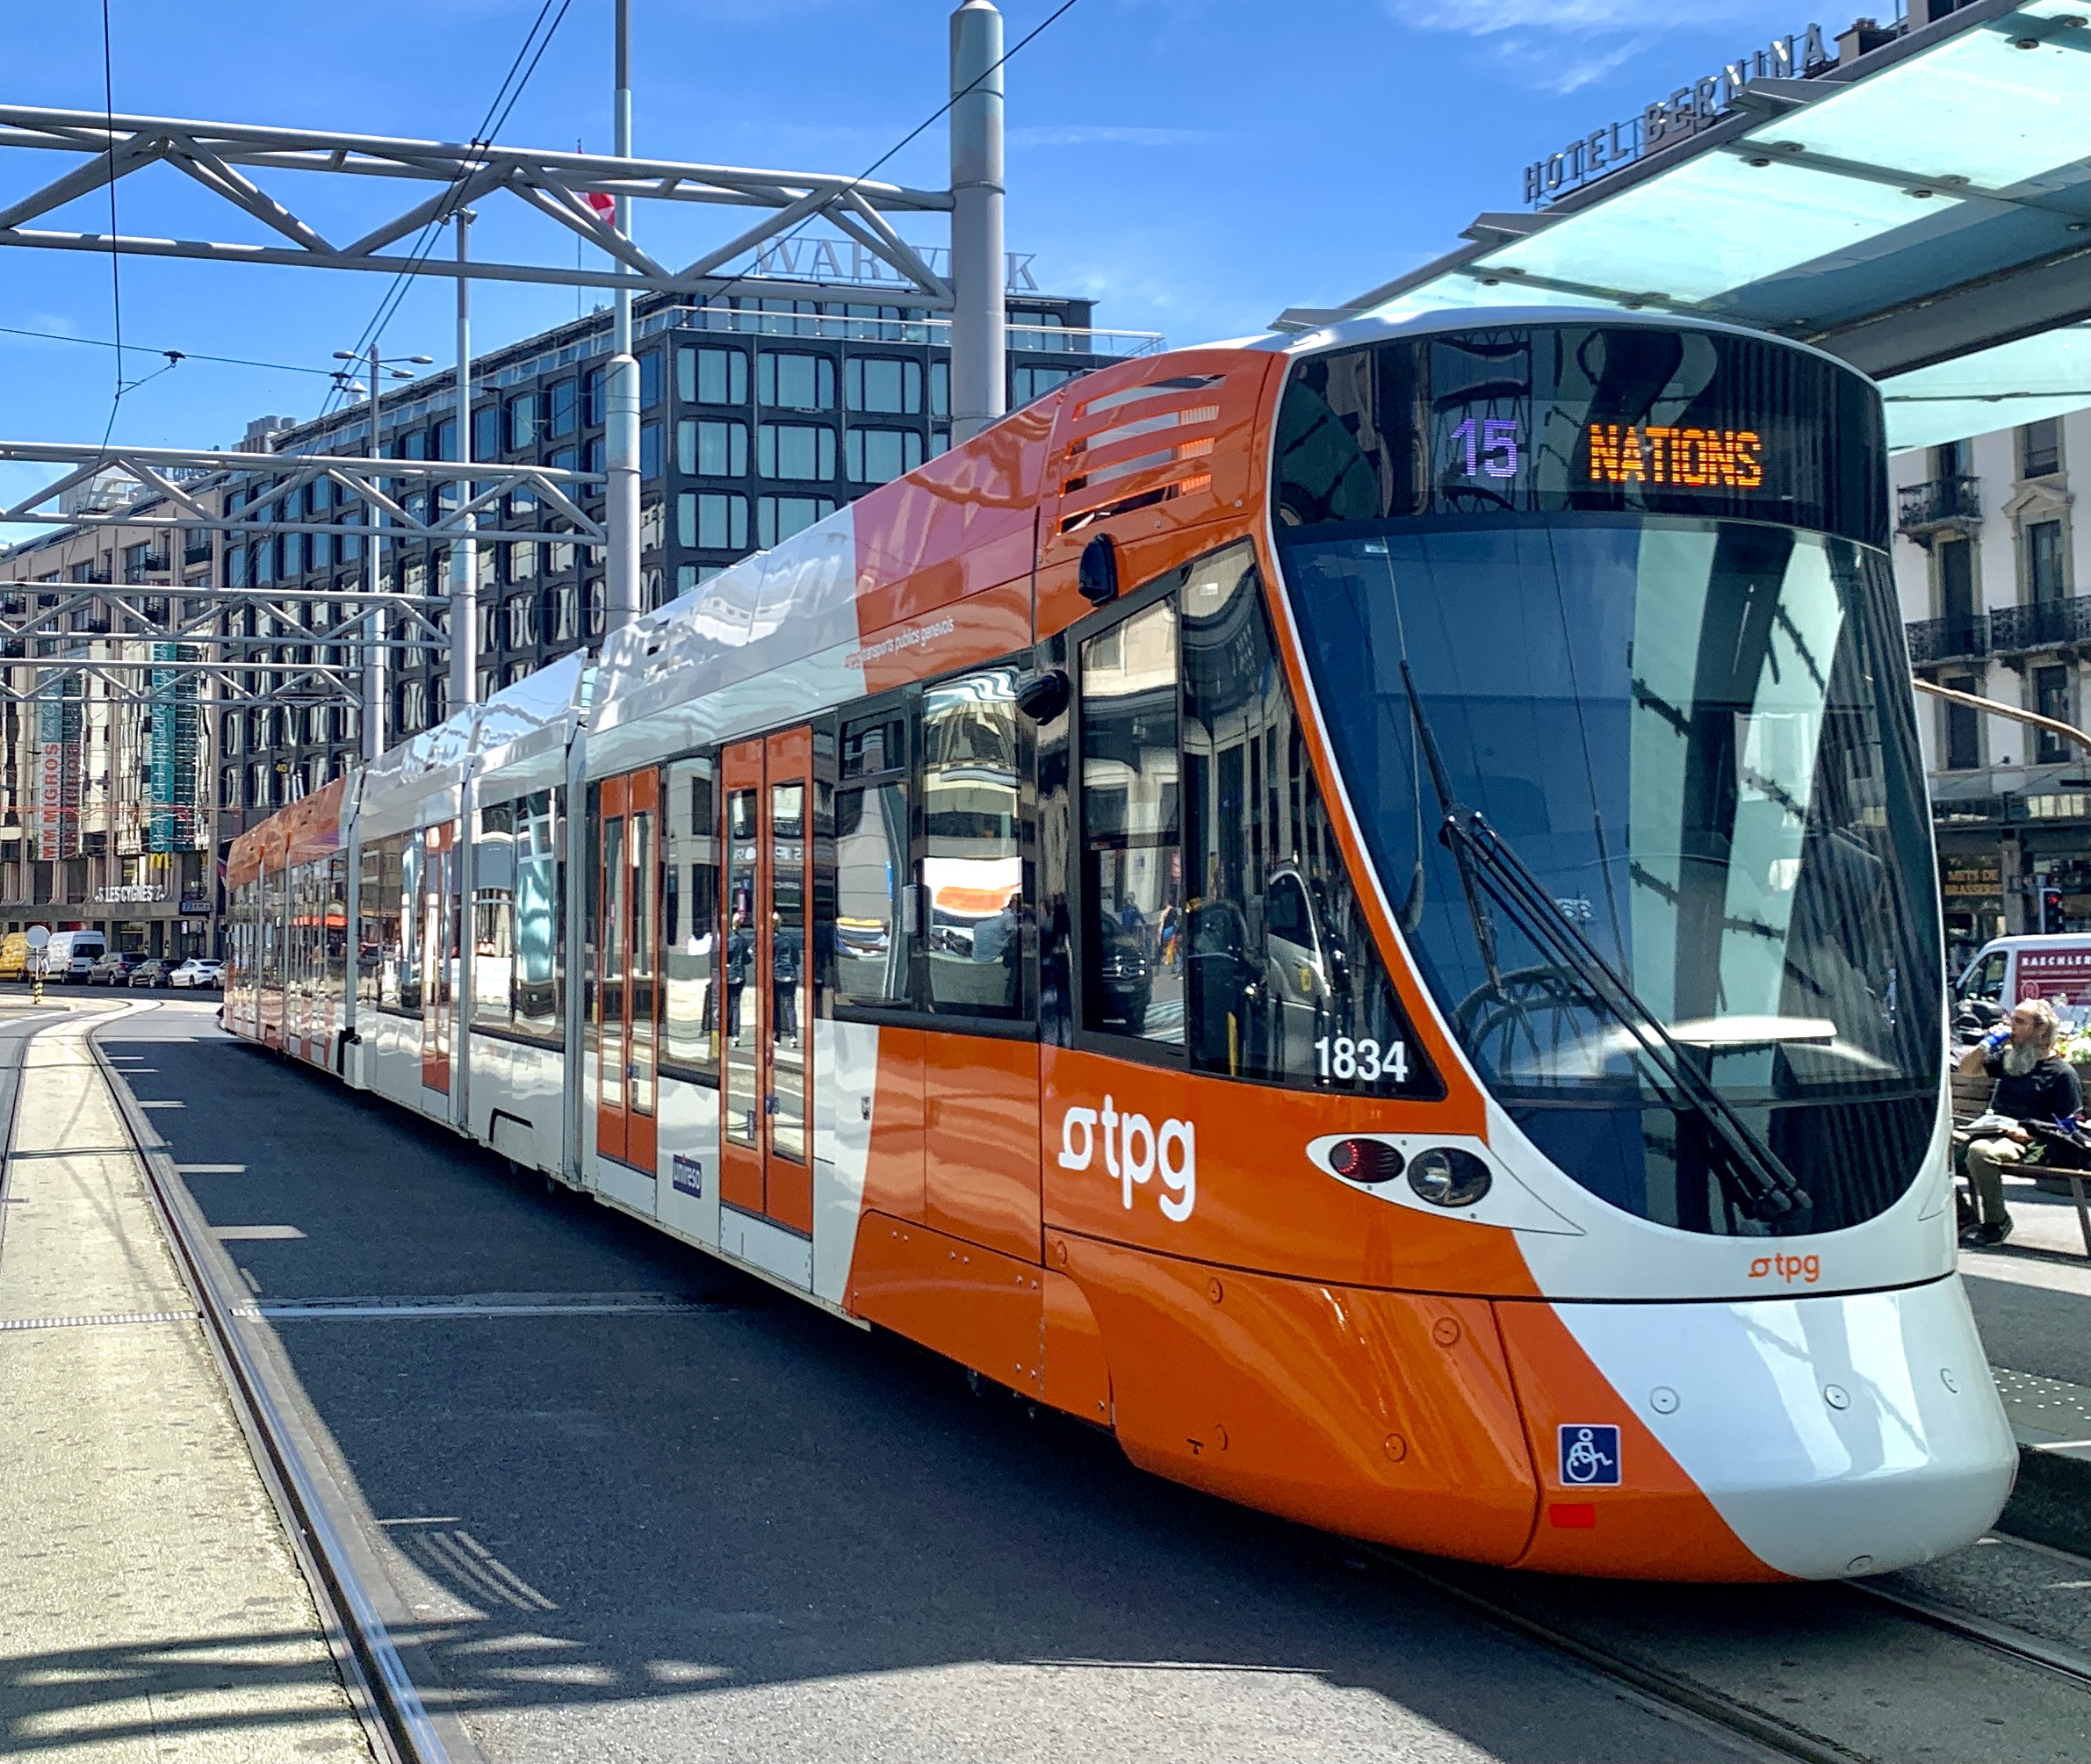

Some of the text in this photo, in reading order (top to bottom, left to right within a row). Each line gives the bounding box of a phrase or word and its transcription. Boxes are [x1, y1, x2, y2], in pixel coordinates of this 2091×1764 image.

[1524, 22, 1827, 205] HOTEL BERNINA
[1450, 418, 1518, 478] 15
[1590, 423, 1762, 489] NATIONS
[44, 744, 58, 824] MIGROS
[1315, 1036, 1408, 1082] 1834
